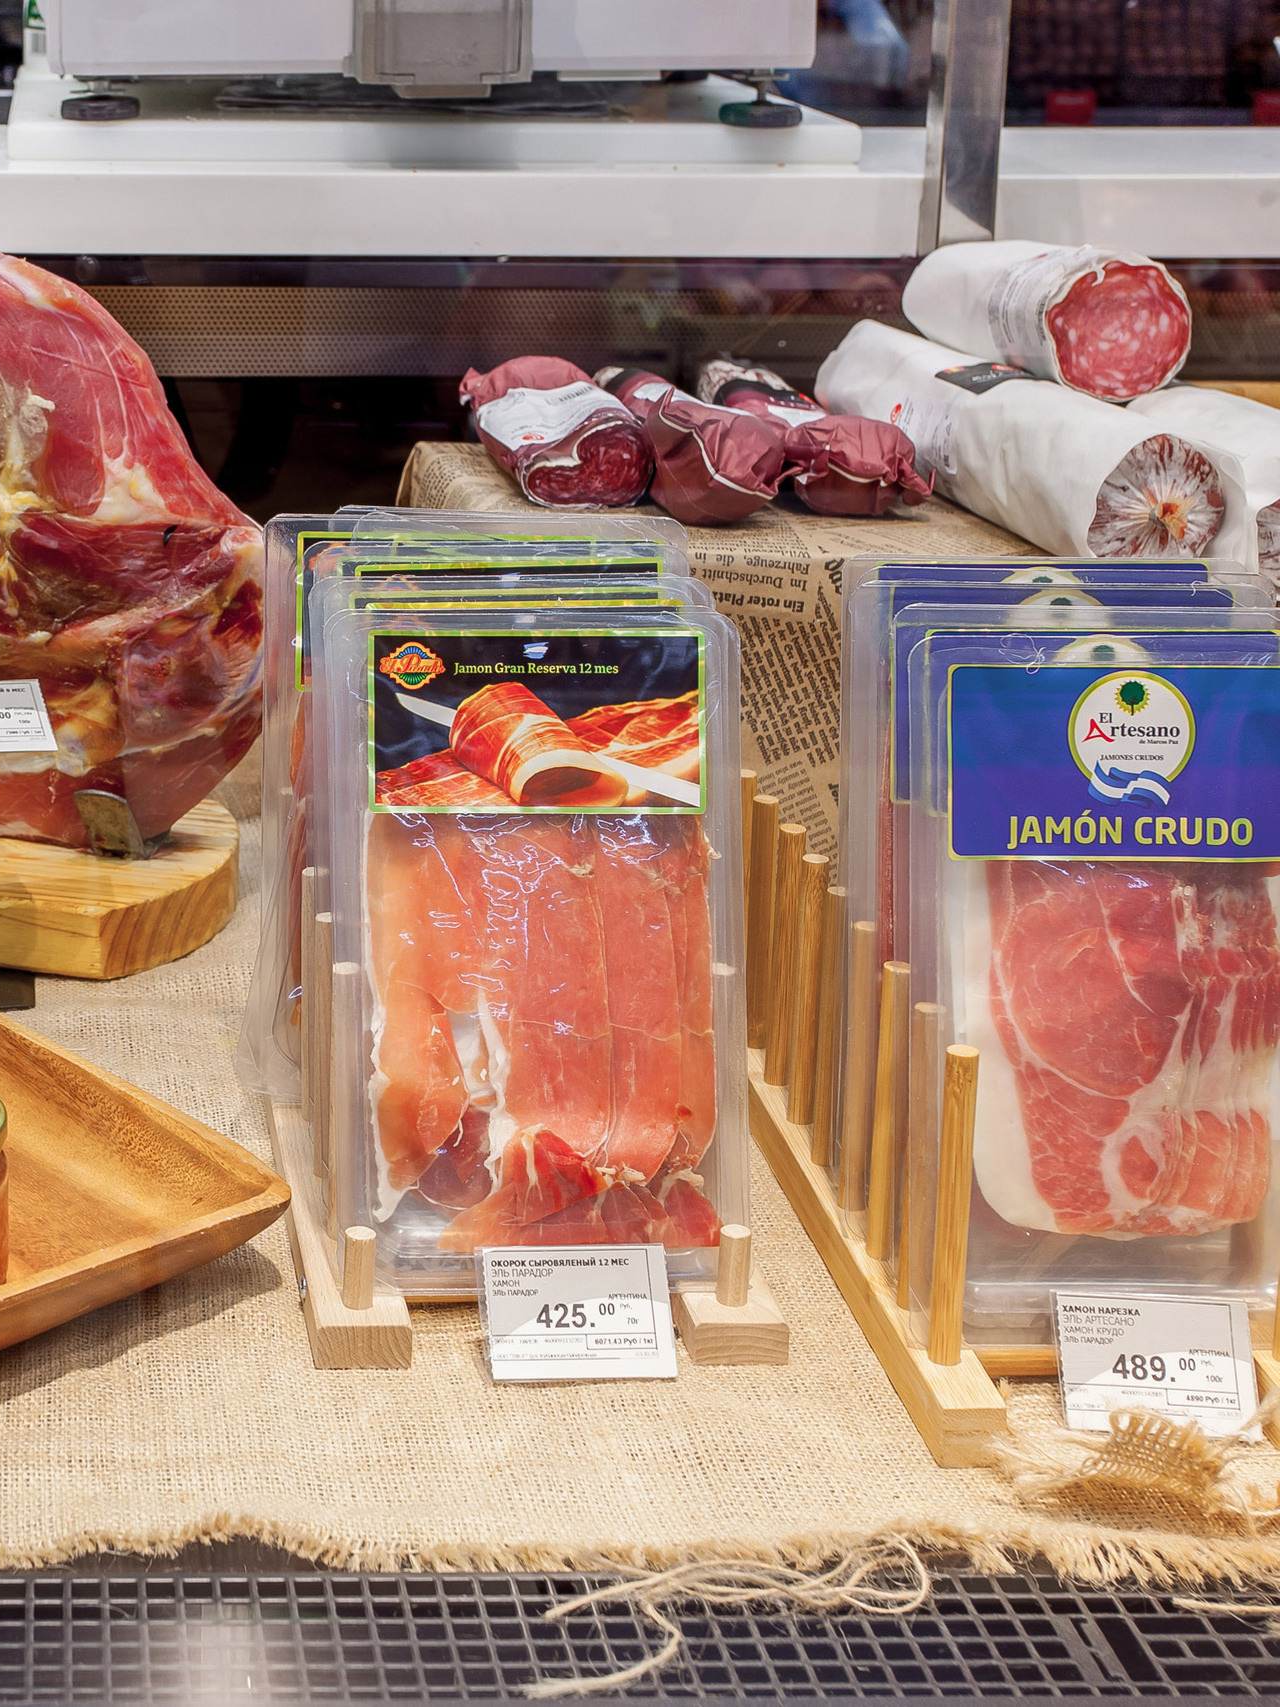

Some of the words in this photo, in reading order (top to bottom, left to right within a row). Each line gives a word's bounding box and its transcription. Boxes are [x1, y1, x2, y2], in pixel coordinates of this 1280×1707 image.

[695, 552, 706, 560] in
[716, 555, 734, 564] die
[744, 555, 810, 574] Fahrzeuge,
[702, 568, 783, 588] Durchschnitt
[790, 579, 807, 591] Im
[747, 595, 780, 607] roter
[783, 601, 804, 613] Ein
[453, 662, 493, 675] Jamon
[495, 663, 525, 674] Gran
[528, 663, 576, 674] Reserva
[579, 663, 592, 674] 12
[594, 664, 618, 674] mes
[1099, 713, 1112, 723] El
[1082, 718, 1180, 742] Artesano
[1007, 810, 1123, 850] JAMÓN
[1134, 816, 1254, 846] CRUDO
[491, 1259, 526, 1267] ОКОРОК
[528, 1257, 596, 1267] СЫРОВЯЛЕНЫЙ
[611, 1258, 630, 1266] МЕС
[491, 1269, 510, 1278] ЭЛЬ
[511, 1268, 554, 1278] ПАРАДОР
[492, 1279, 520, 1287] ХАМОН
[507, 1289, 539, 1297] ПАРАДОР
[1062, 1305, 1096, 1314] ХАМОН
[1098, 1307, 1141, 1317] НАРЕЗКА
[1062, 1314, 1083, 1324] ЭЛЬ
[1085, 1315, 1135, 1327] АРТЕСАНО
[1064, 1326, 1094, 1334] ХАМОН
[1096, 1327, 1125, 1336] КРУДО
[1064, 1335, 1079, 1343] ЭЛЬ
[1080, 1336, 1114, 1345] ПАРАДОР
[1188, 1348, 1230, 1357] АРГЕНТИНА
